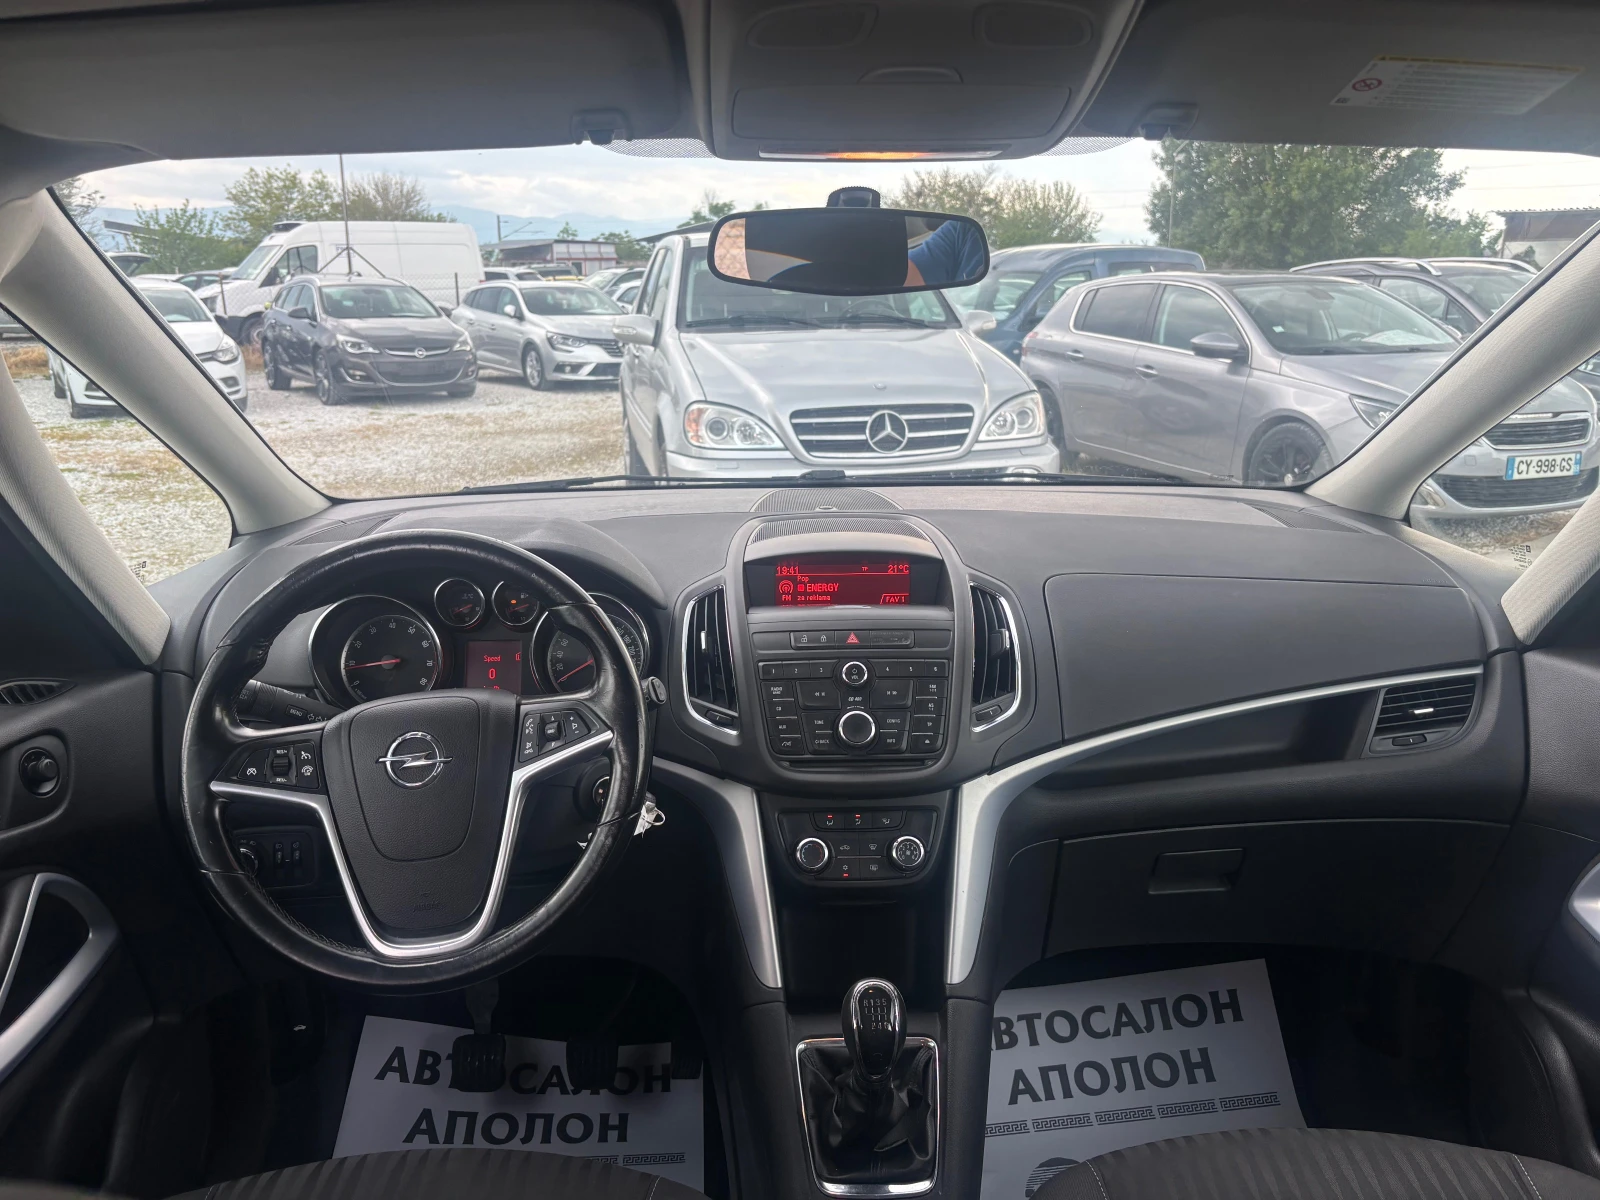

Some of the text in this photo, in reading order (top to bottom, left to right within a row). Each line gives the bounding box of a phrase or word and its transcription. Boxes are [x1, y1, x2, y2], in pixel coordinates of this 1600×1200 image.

[1517, 457, 1573, 475] CY-998-GS
[776, 565, 799, 575] 19:41
[887, 564, 910, 575] 21°C
[797, 575, 810, 583] Pop
[806, 583, 839, 592] ENERGY
[388, 621, 397, 629] 40
[407, 625, 416, 635] 50
[354, 640, 362, 649] 20
[560, 638, 569, 647] 60
[483, 654, 501, 663] Speed
[556, 650, 564, 659] 40
[556, 663, 564, 671] 20
[488, 668, 496, 679] 0
[419, 677, 428, 686] 80
[991, 988, 1244, 1051] ВТОСАЛОН
[374, 1046, 672, 1095] АВСАОН
[1008, 1047, 1217, 1105] АПОЛОН
[402, 1108, 630, 1146] АПОЛОН
